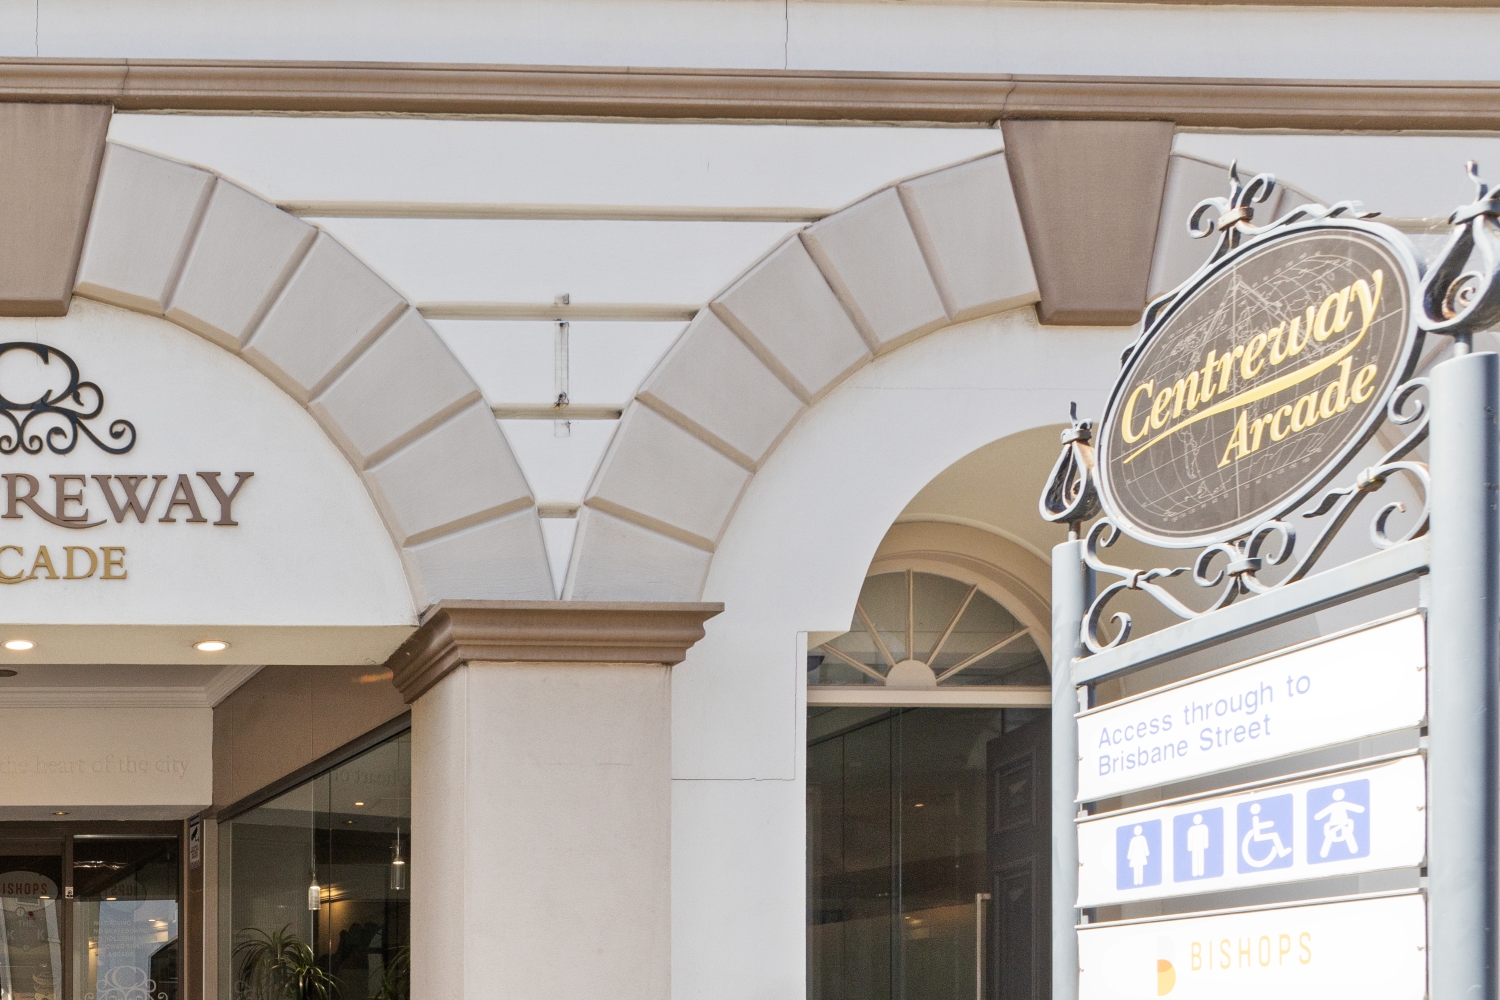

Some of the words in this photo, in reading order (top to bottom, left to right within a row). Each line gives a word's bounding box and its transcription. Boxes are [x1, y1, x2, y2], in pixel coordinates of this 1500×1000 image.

[1121, 269, 1384, 455] Centreway
[1218, 358, 1378, 468] Arcade
[1098, 713, 1174, 749] Access
[1183, 681, 1275, 727] through
[1286, 674, 1312, 700] to
[1098, 737, 1189, 777] Brisbane
[1198, 714, 1272, 752] Street
[35, 756, 85, 773] heart
[92, 754, 113, 773] of
[119, 755, 148, 774] the
[155, 755, 190, 779] city
[1190, 931, 1313, 971] BISHOPS
